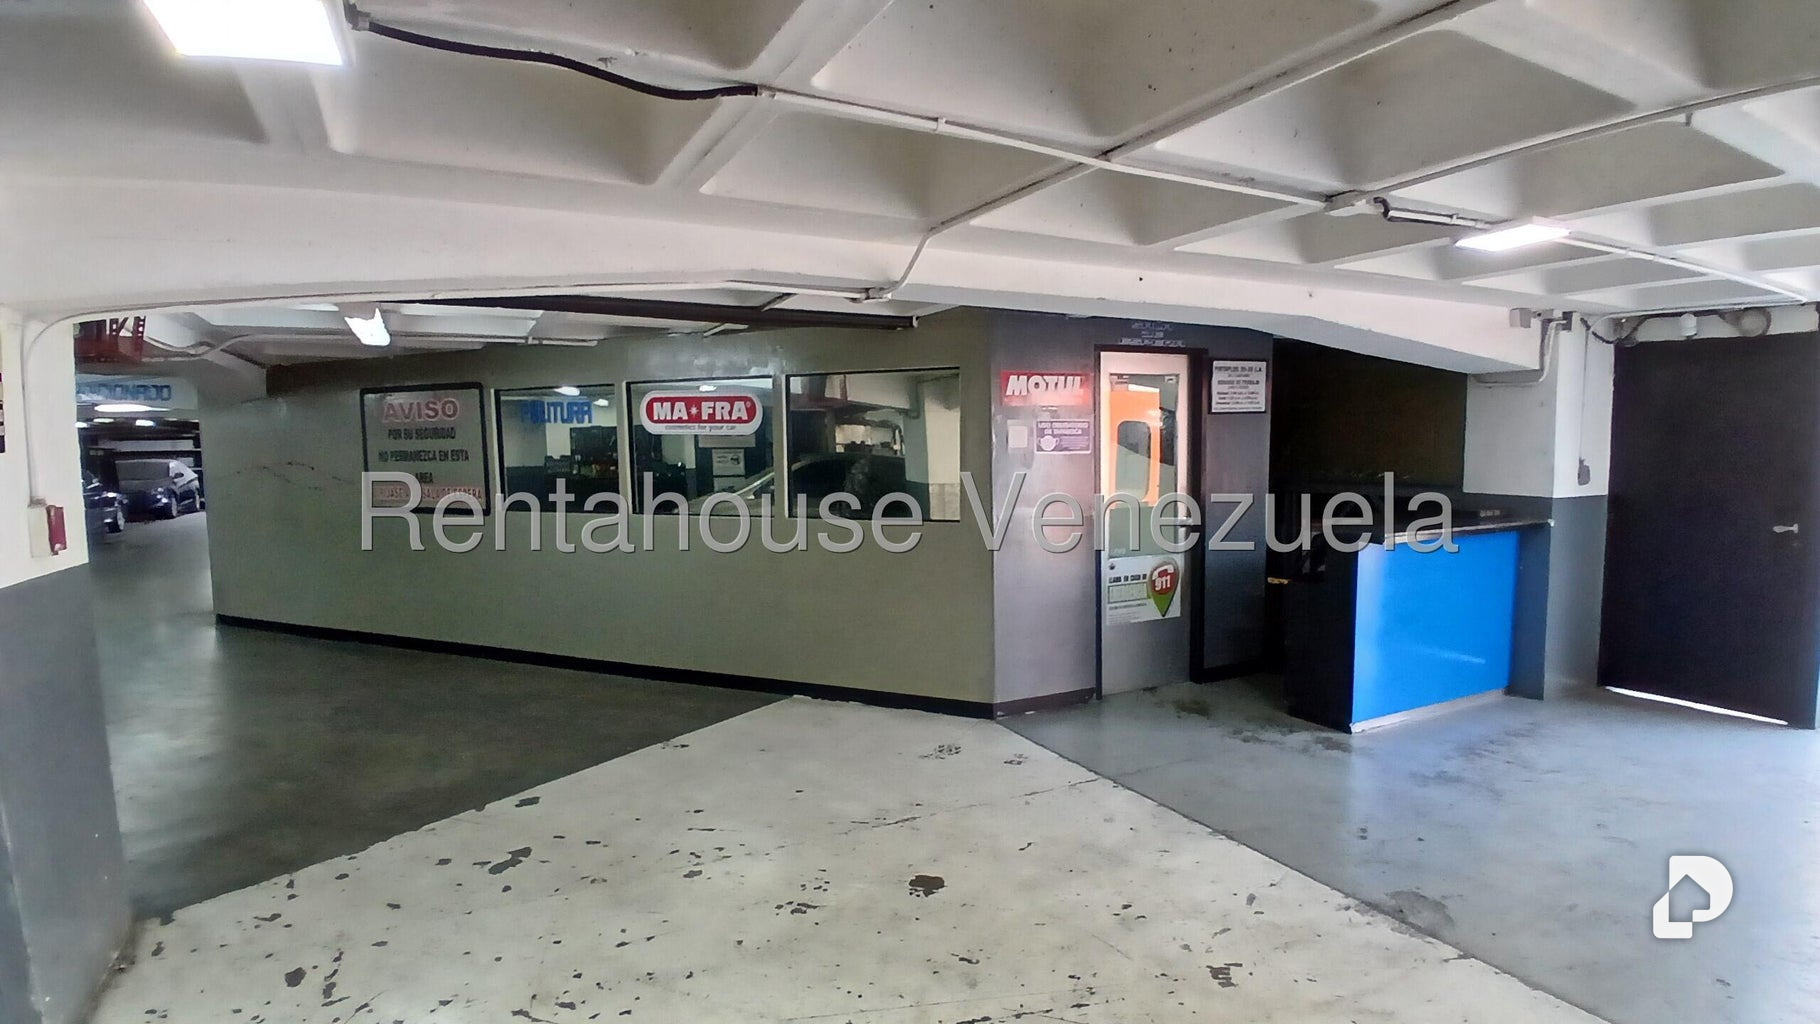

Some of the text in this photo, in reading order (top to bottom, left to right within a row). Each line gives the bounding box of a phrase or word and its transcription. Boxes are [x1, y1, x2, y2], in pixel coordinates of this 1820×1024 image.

[1005, 375, 1084, 396] MOTUL
[383, 398, 459, 422] AVISO
[388, 427, 456, 440] POR SU SEGURIDAD
[709, 424, 725, 432] your
[378, 449, 470, 462] NO PERMANEZCA EN ESTA
[1155, 575, 1170, 590] 911
